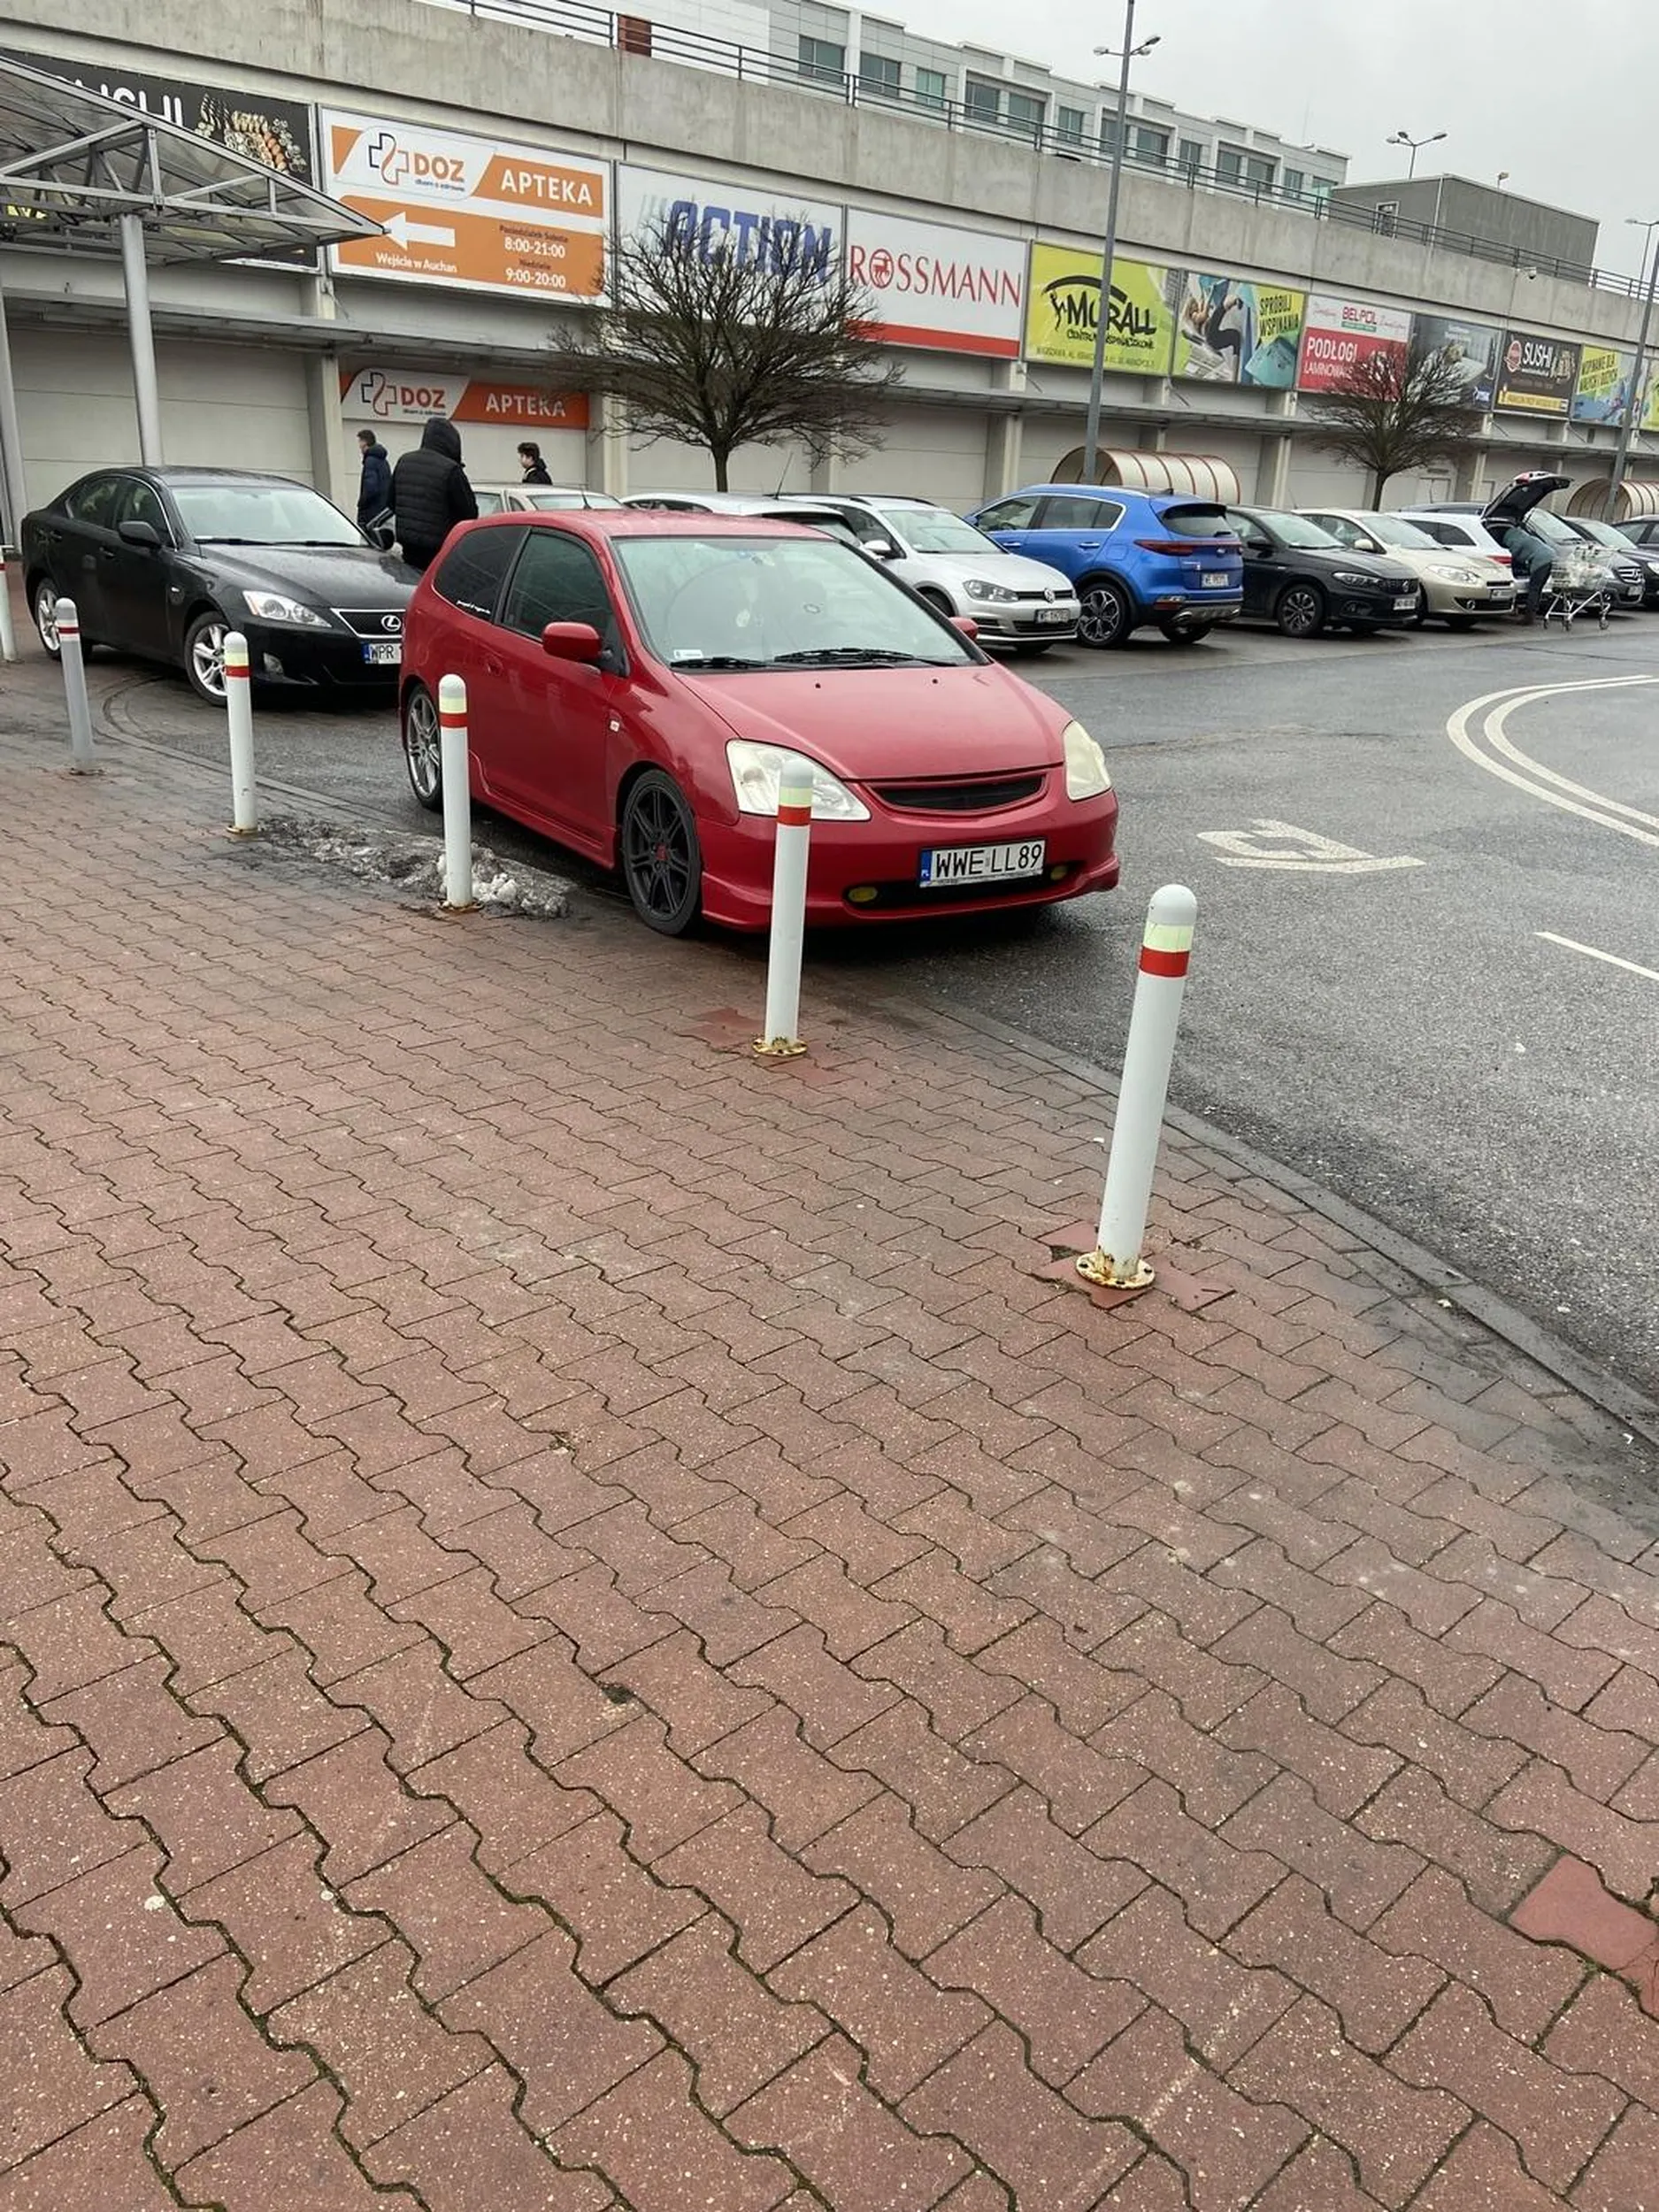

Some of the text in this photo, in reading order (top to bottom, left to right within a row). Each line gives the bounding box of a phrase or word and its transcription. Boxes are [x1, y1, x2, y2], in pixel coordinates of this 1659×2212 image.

[414, 152, 465, 182] DOZ
[501, 169, 593, 206] APTEKA
[504, 236, 565, 258] 8:00-21:00
[662, 200, 833, 283] ACTION
[505, 267, 566, 288] 9:00-20:00
[850, 245, 1021, 308] ROSSMANN
[1306, 336, 1357, 363] PODŁOGI
[1523, 342, 1554, 368] SUSHI
[401, 387, 446, 409] DOZ
[486, 393, 566, 418] APTEKA
[936, 843, 1042, 878] WWE LL89
